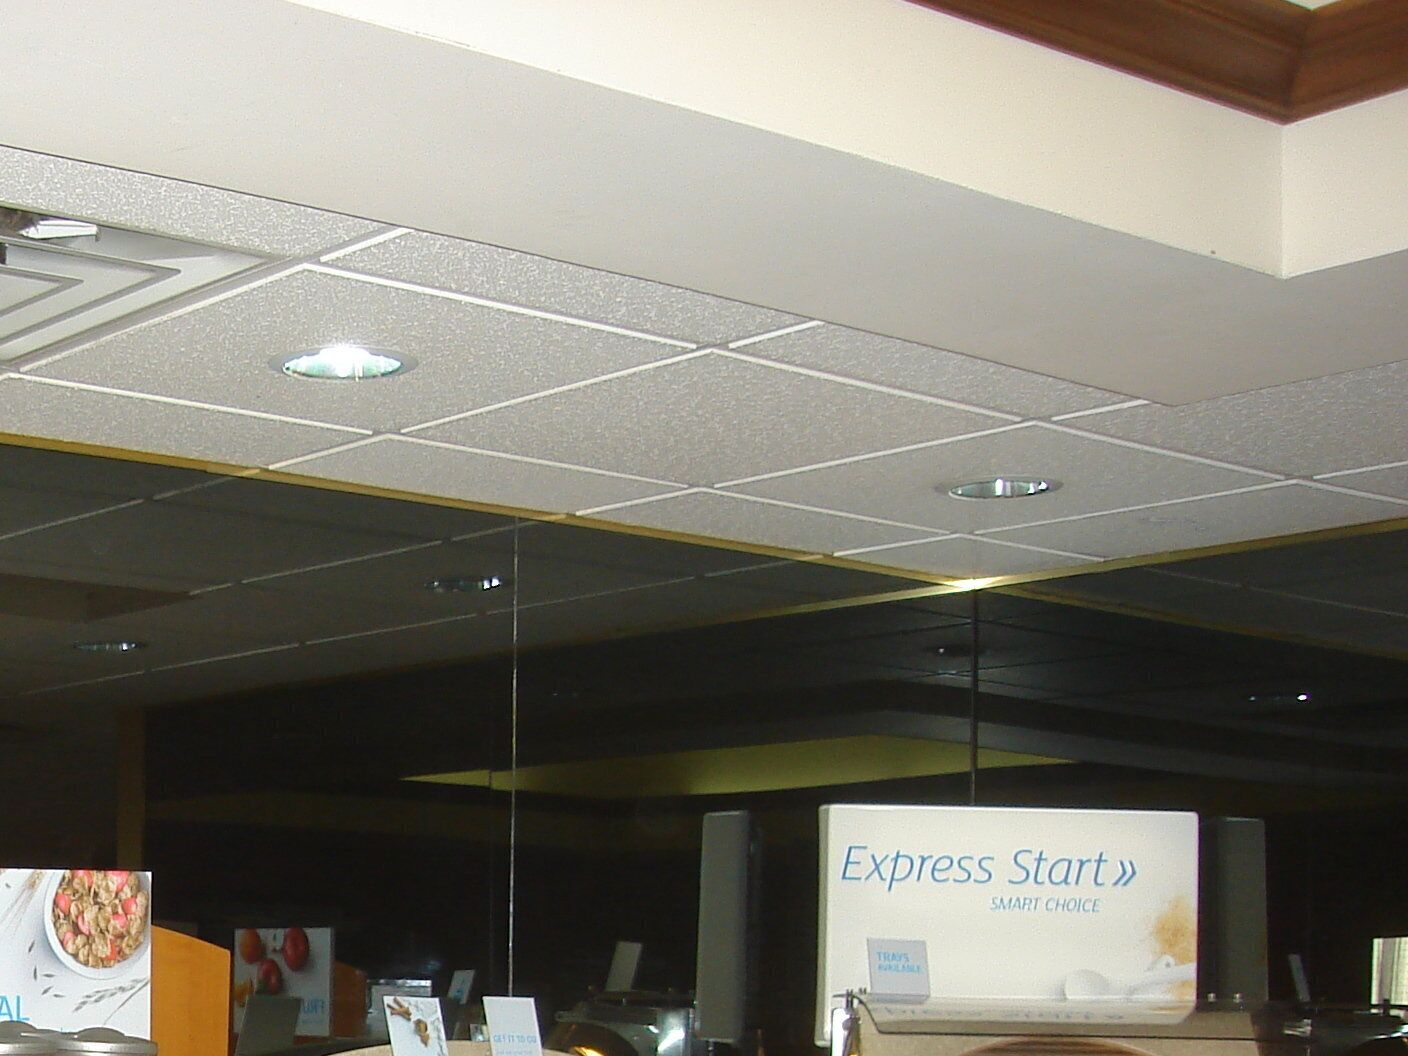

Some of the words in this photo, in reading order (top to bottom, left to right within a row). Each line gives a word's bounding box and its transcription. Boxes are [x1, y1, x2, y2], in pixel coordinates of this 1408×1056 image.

[841, 844, 995, 893] Express
[1007, 849, 1109, 887] Start
[989, 896, 1042, 912] SMART
[1045, 897, 1102, 914] CHOICE
